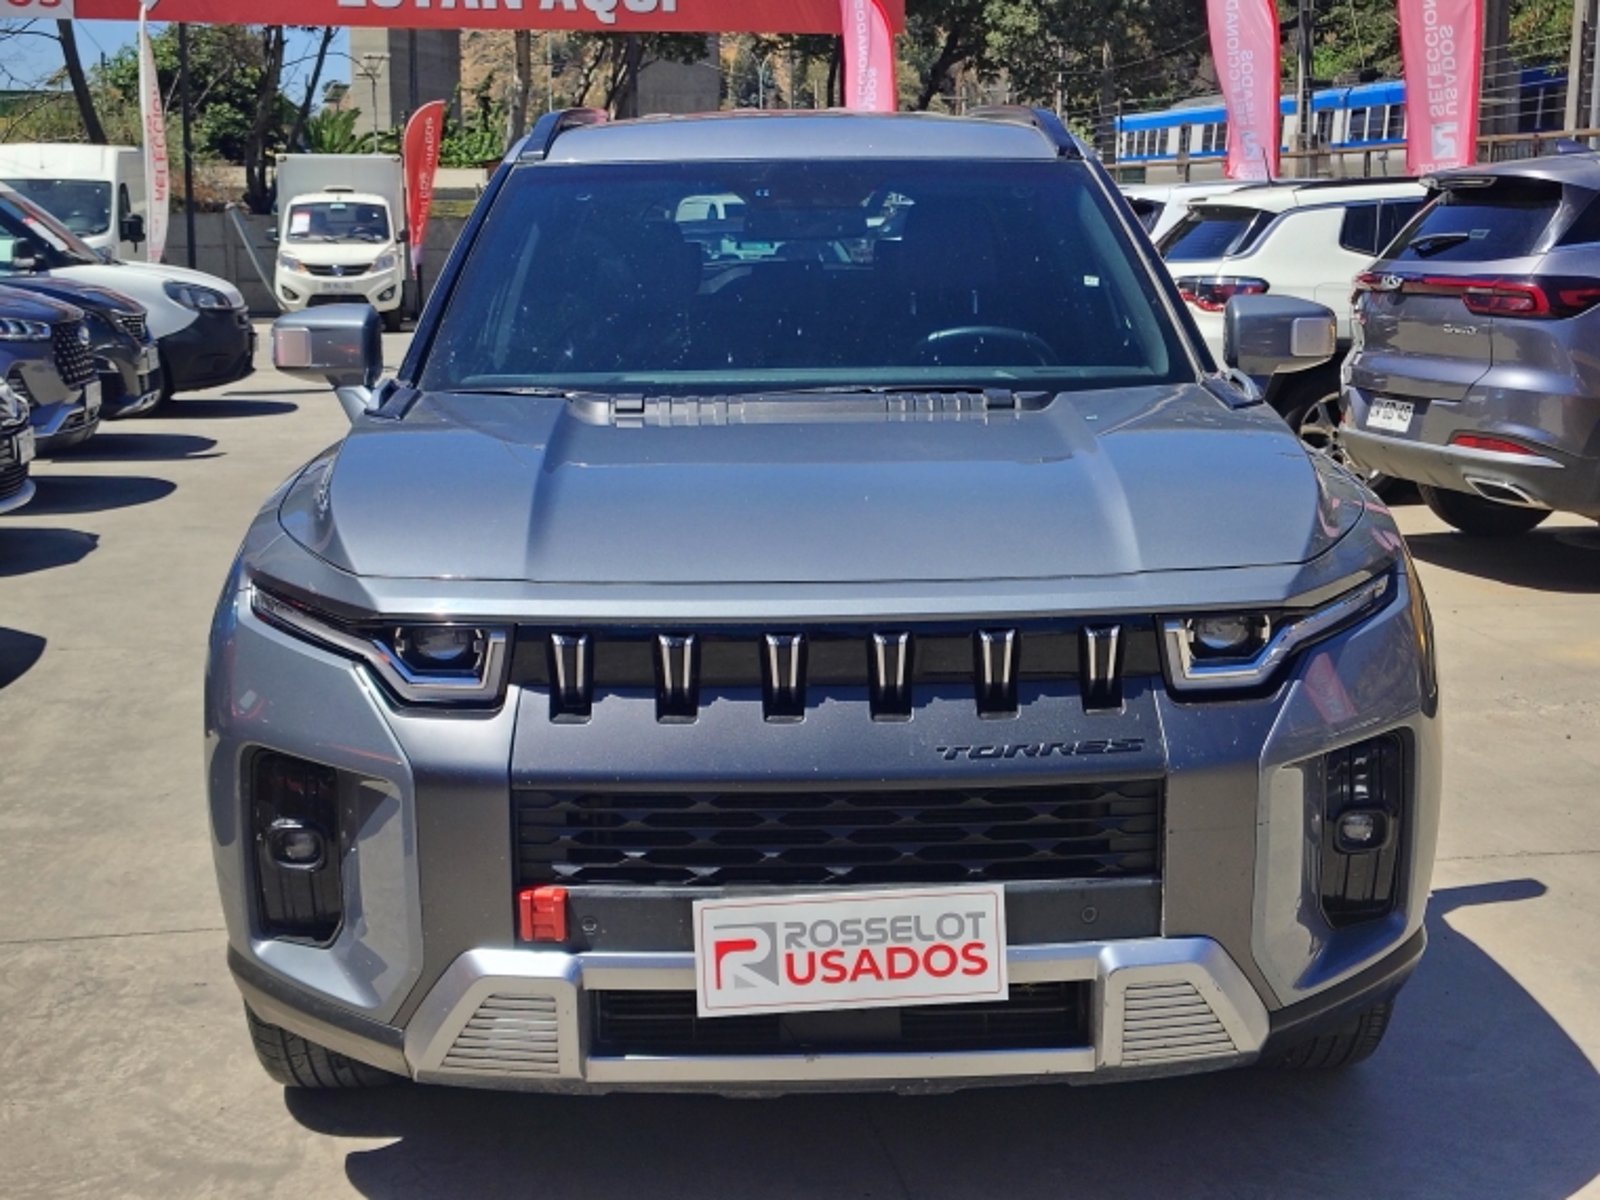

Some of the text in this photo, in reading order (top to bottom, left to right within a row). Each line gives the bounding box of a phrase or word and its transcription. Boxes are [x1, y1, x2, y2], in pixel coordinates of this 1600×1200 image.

[936, 738, 1145, 760] TORRES
[784, 911, 986, 950] ROSSELOT
[785, 942, 989, 986] USADOS
